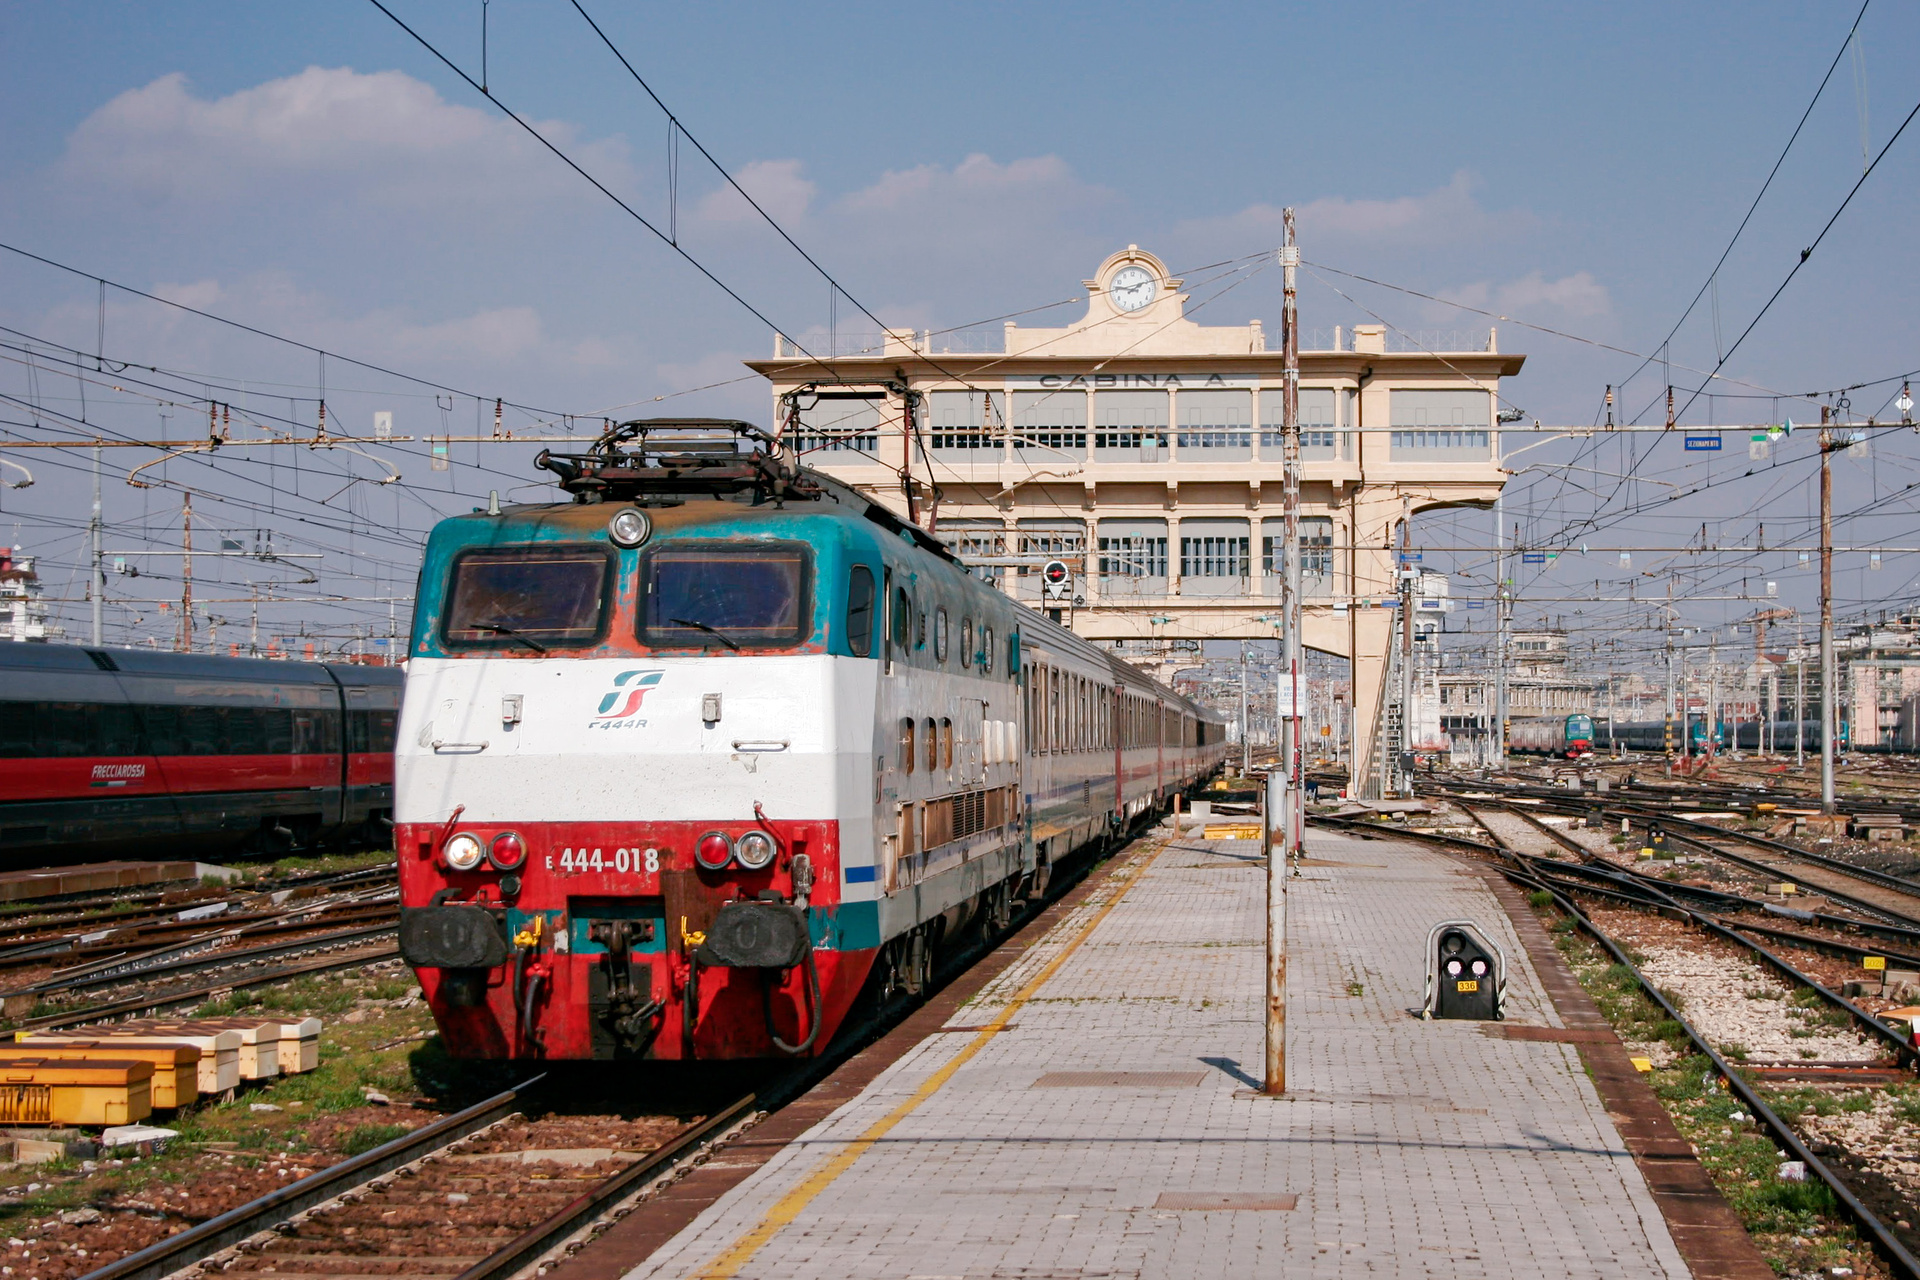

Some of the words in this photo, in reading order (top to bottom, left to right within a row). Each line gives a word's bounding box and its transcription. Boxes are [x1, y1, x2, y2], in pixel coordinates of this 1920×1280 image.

[1039, 374, 1184, 388] CABINA
[378, 419, 388, 434] 4
[92, 764, 146, 778] FRECCIAROSSA
[545, 855, 553, 869] E
[560, 847, 660, 873] 444-018
[1459, 982, 1476, 990] 336
